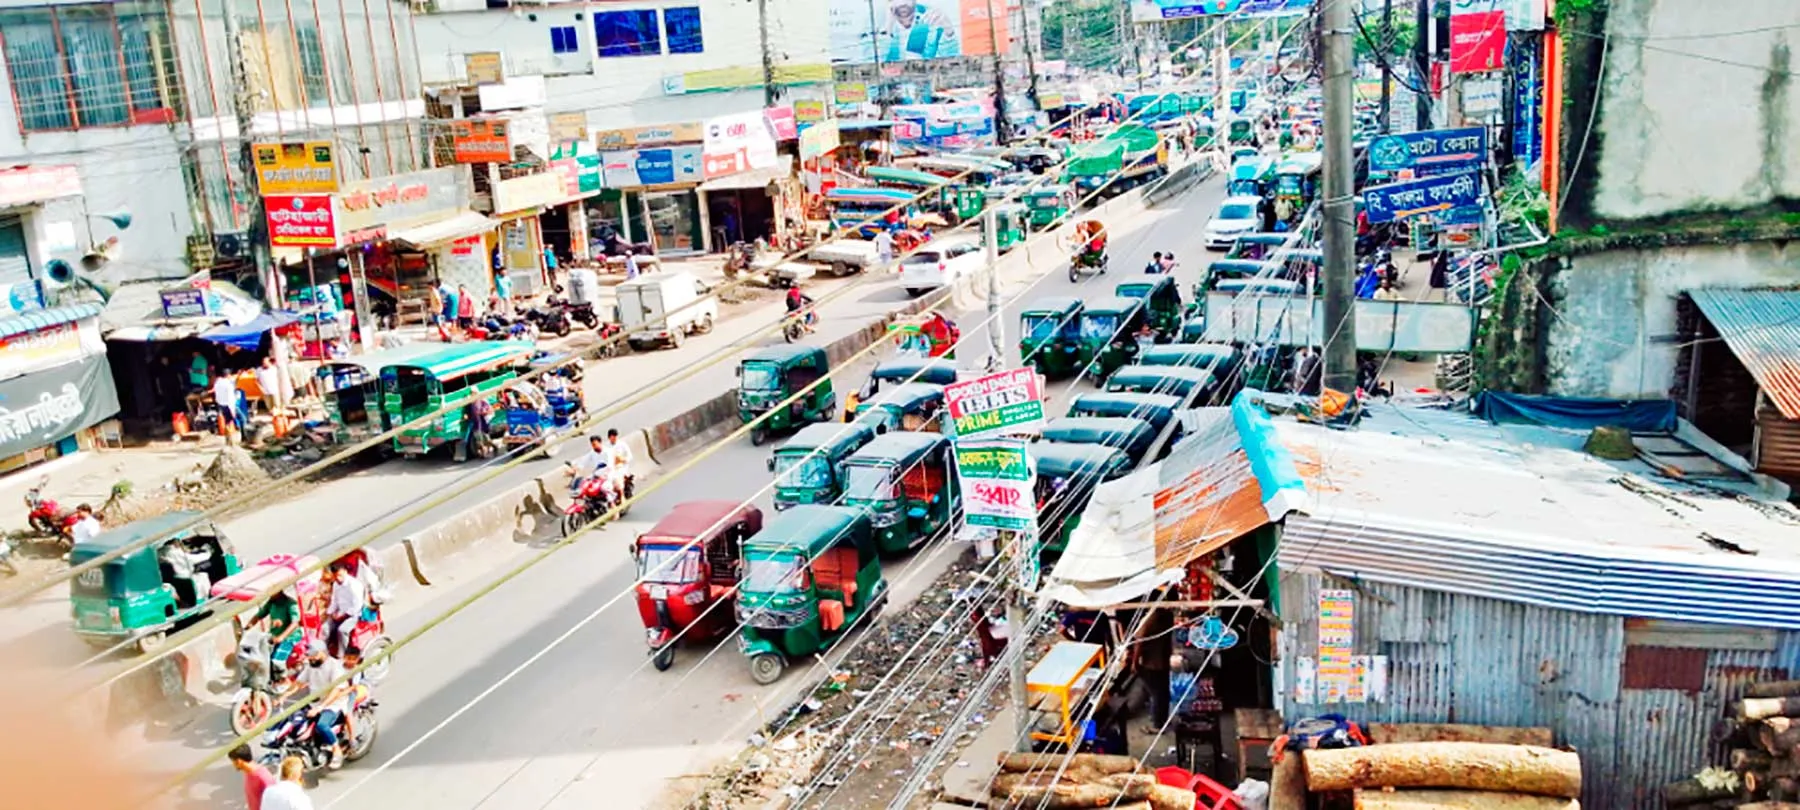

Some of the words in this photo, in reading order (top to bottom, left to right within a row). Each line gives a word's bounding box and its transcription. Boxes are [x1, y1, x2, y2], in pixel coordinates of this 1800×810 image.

[1408, 137, 1438, 154] অটো
[1442, 135, 1480, 151] কেয়ার
[1389, 188, 1425, 208] আলম
[270, 208, 329, 223] হাটহাজারী
[948, 381, 987, 400] SPOKEN
[987, 371, 1031, 391] ENGLISH
[961, 386, 1028, 413] IELTS
[956, 410, 1002, 433] PRIME
